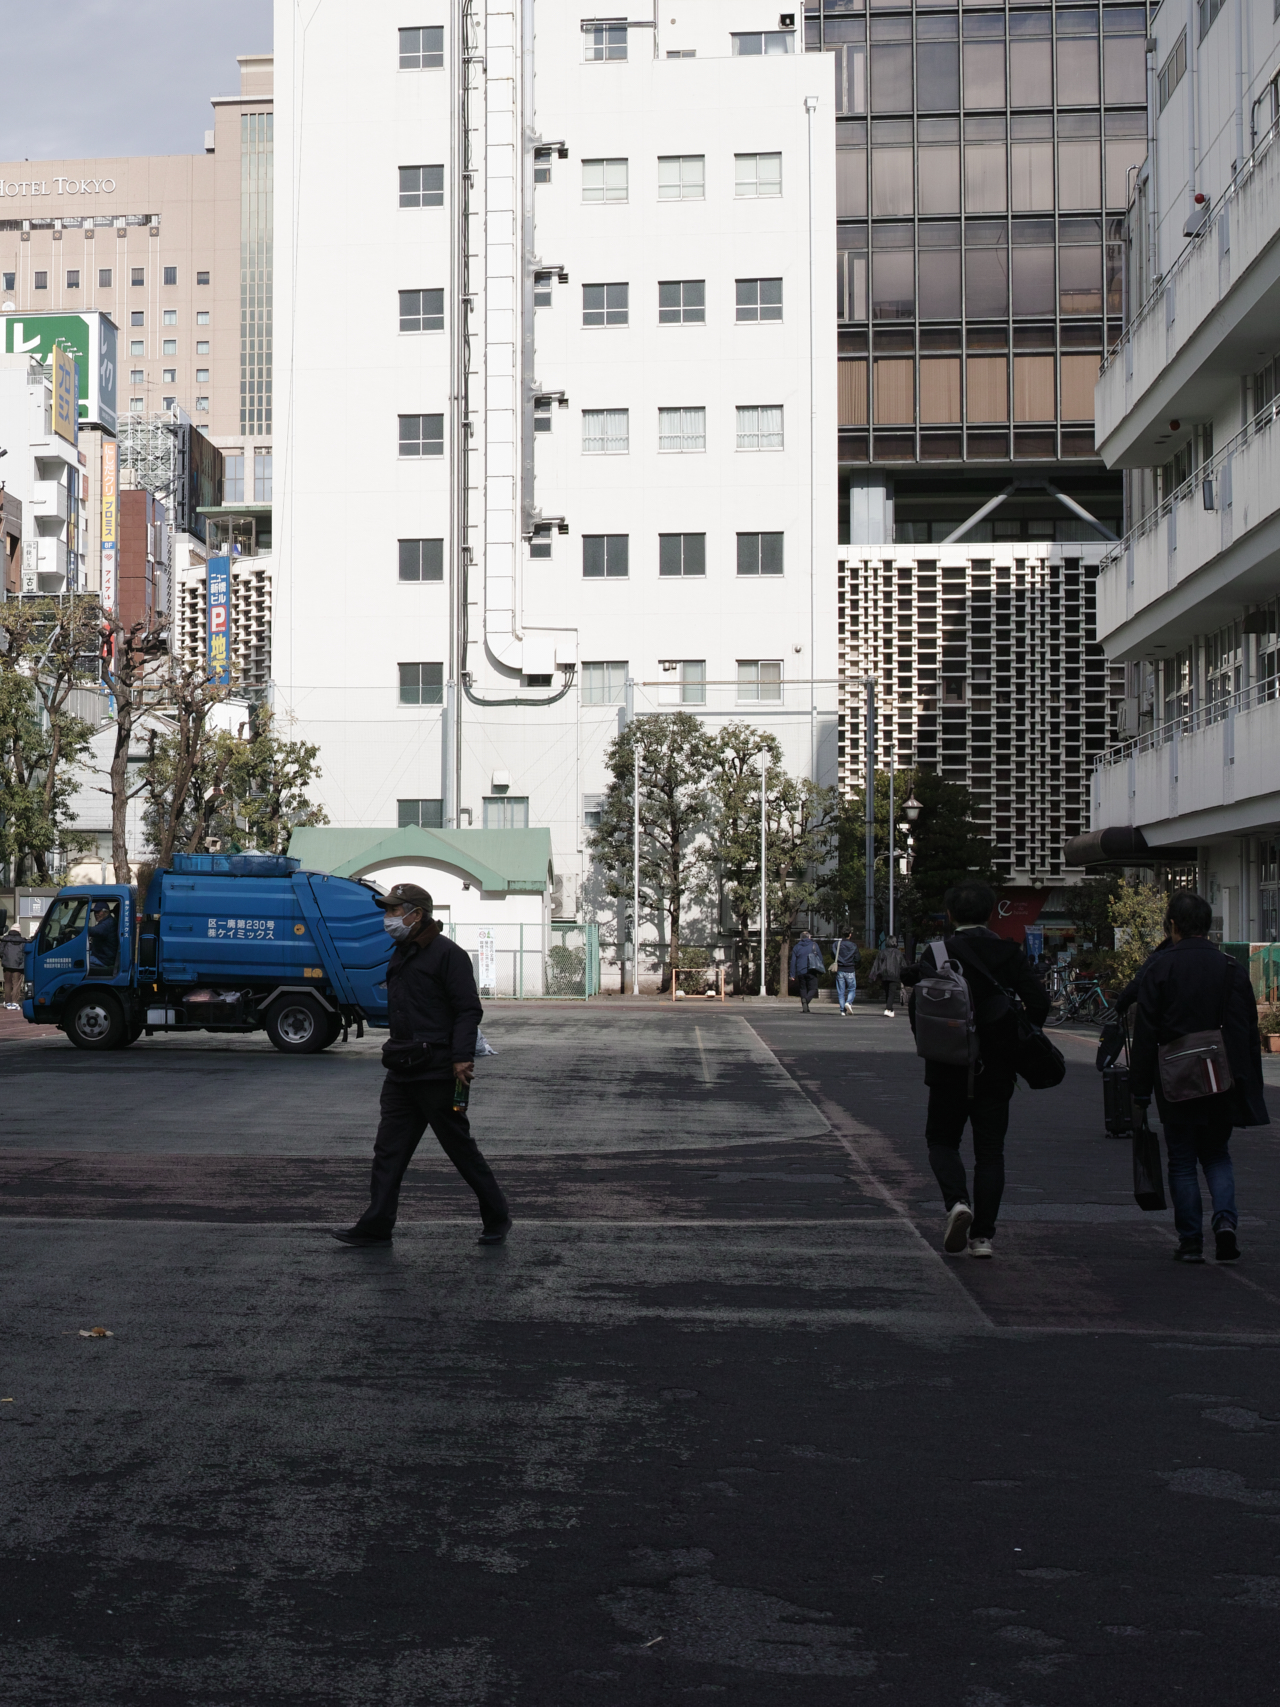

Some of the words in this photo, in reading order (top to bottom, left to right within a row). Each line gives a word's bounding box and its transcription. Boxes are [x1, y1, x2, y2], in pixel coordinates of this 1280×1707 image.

[53, 177, 116, 195] TOKYO
[104, 445, 114, 496] にしだクリ
[105, 501, 114, 537] プロミス
[210, 574, 227, 584] ニュー
[210, 582, 226, 594] 新橋
[210, 594, 226, 605] ビル
